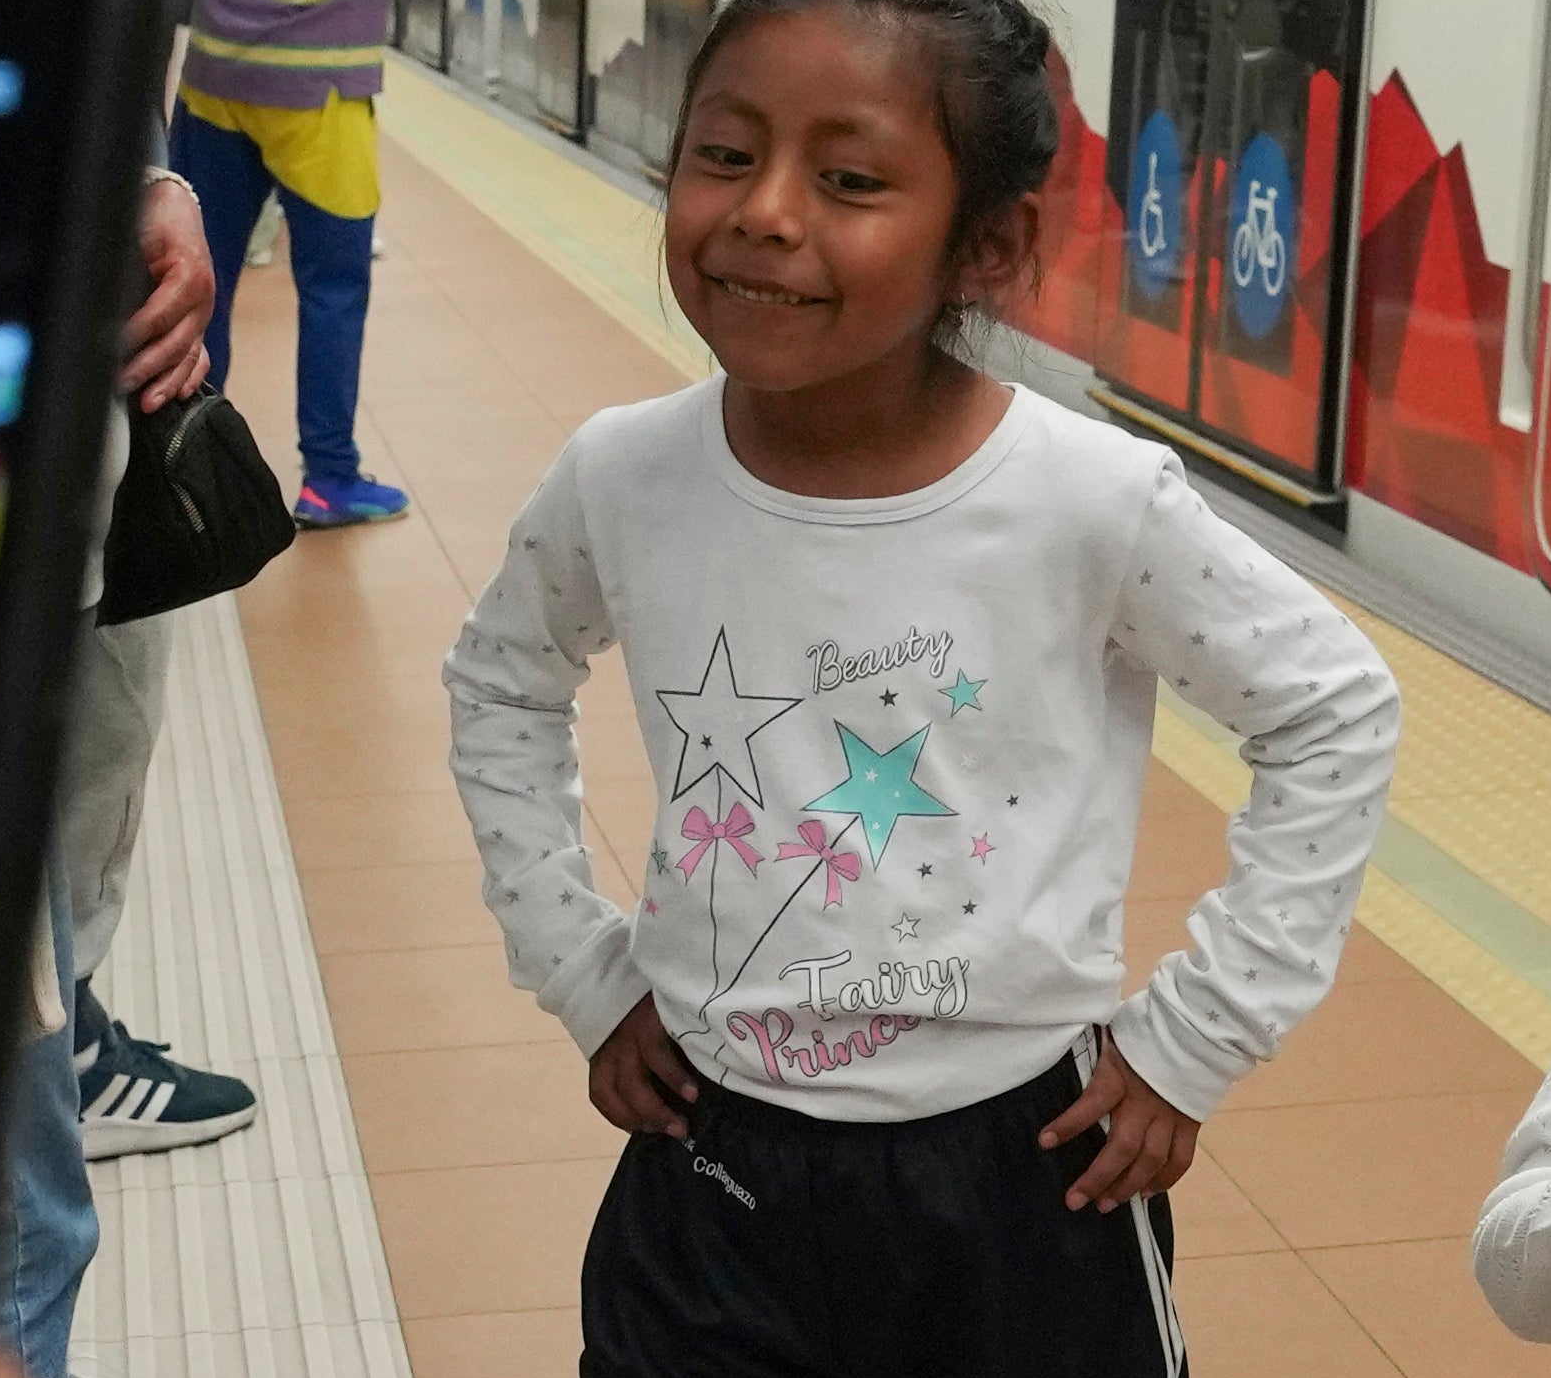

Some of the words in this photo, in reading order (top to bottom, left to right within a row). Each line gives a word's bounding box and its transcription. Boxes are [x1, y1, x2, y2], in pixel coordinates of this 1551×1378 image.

[806, 625, 953, 694] Beauty
[778, 949, 970, 1020] Fairy
[726, 1007, 921, 1084] Princ
[693, 1156, 756, 1210] Collaguazo
